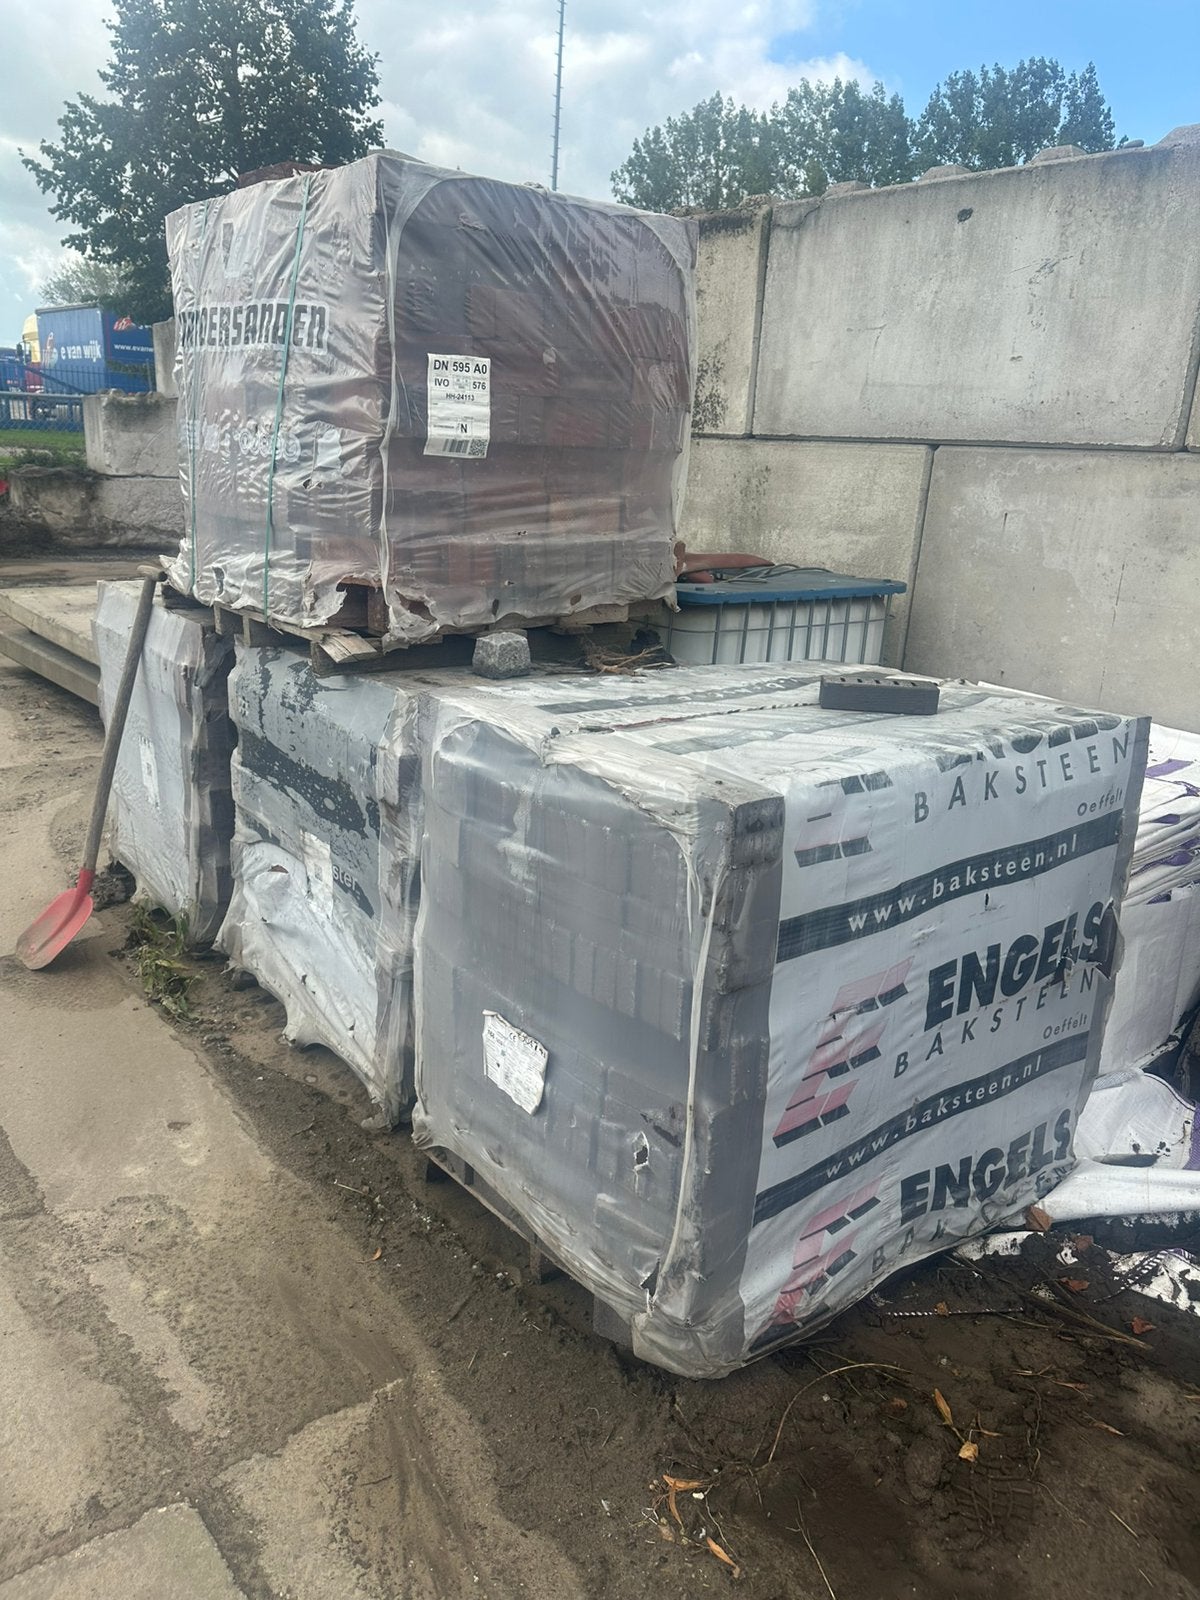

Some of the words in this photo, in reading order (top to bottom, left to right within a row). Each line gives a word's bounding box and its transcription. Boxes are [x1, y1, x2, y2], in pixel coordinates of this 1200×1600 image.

[66, 345, 82, 359] van
[82, 340, 102, 363] wijk
[433, 359, 449, 371] DN
[452, 361, 470, 373] 595
[434, 378, 450, 387] IVO
[472, 381, 486, 390] 576
[460, 423, 468, 433] N
[914, 732, 1129, 823] BAKSTEEN
[848, 834, 1077, 932] www.baksteen.nl
[924, 901, 1104, 1032] ENGELS
[894, 968, 1094, 1078] BAKSTEEN
[1043, 1013, 1087, 1040] Oeffelt
[826, 1055, 1042, 1179] www.baksteen.nl
[900, 1108, 1071, 1226] ENGELS
